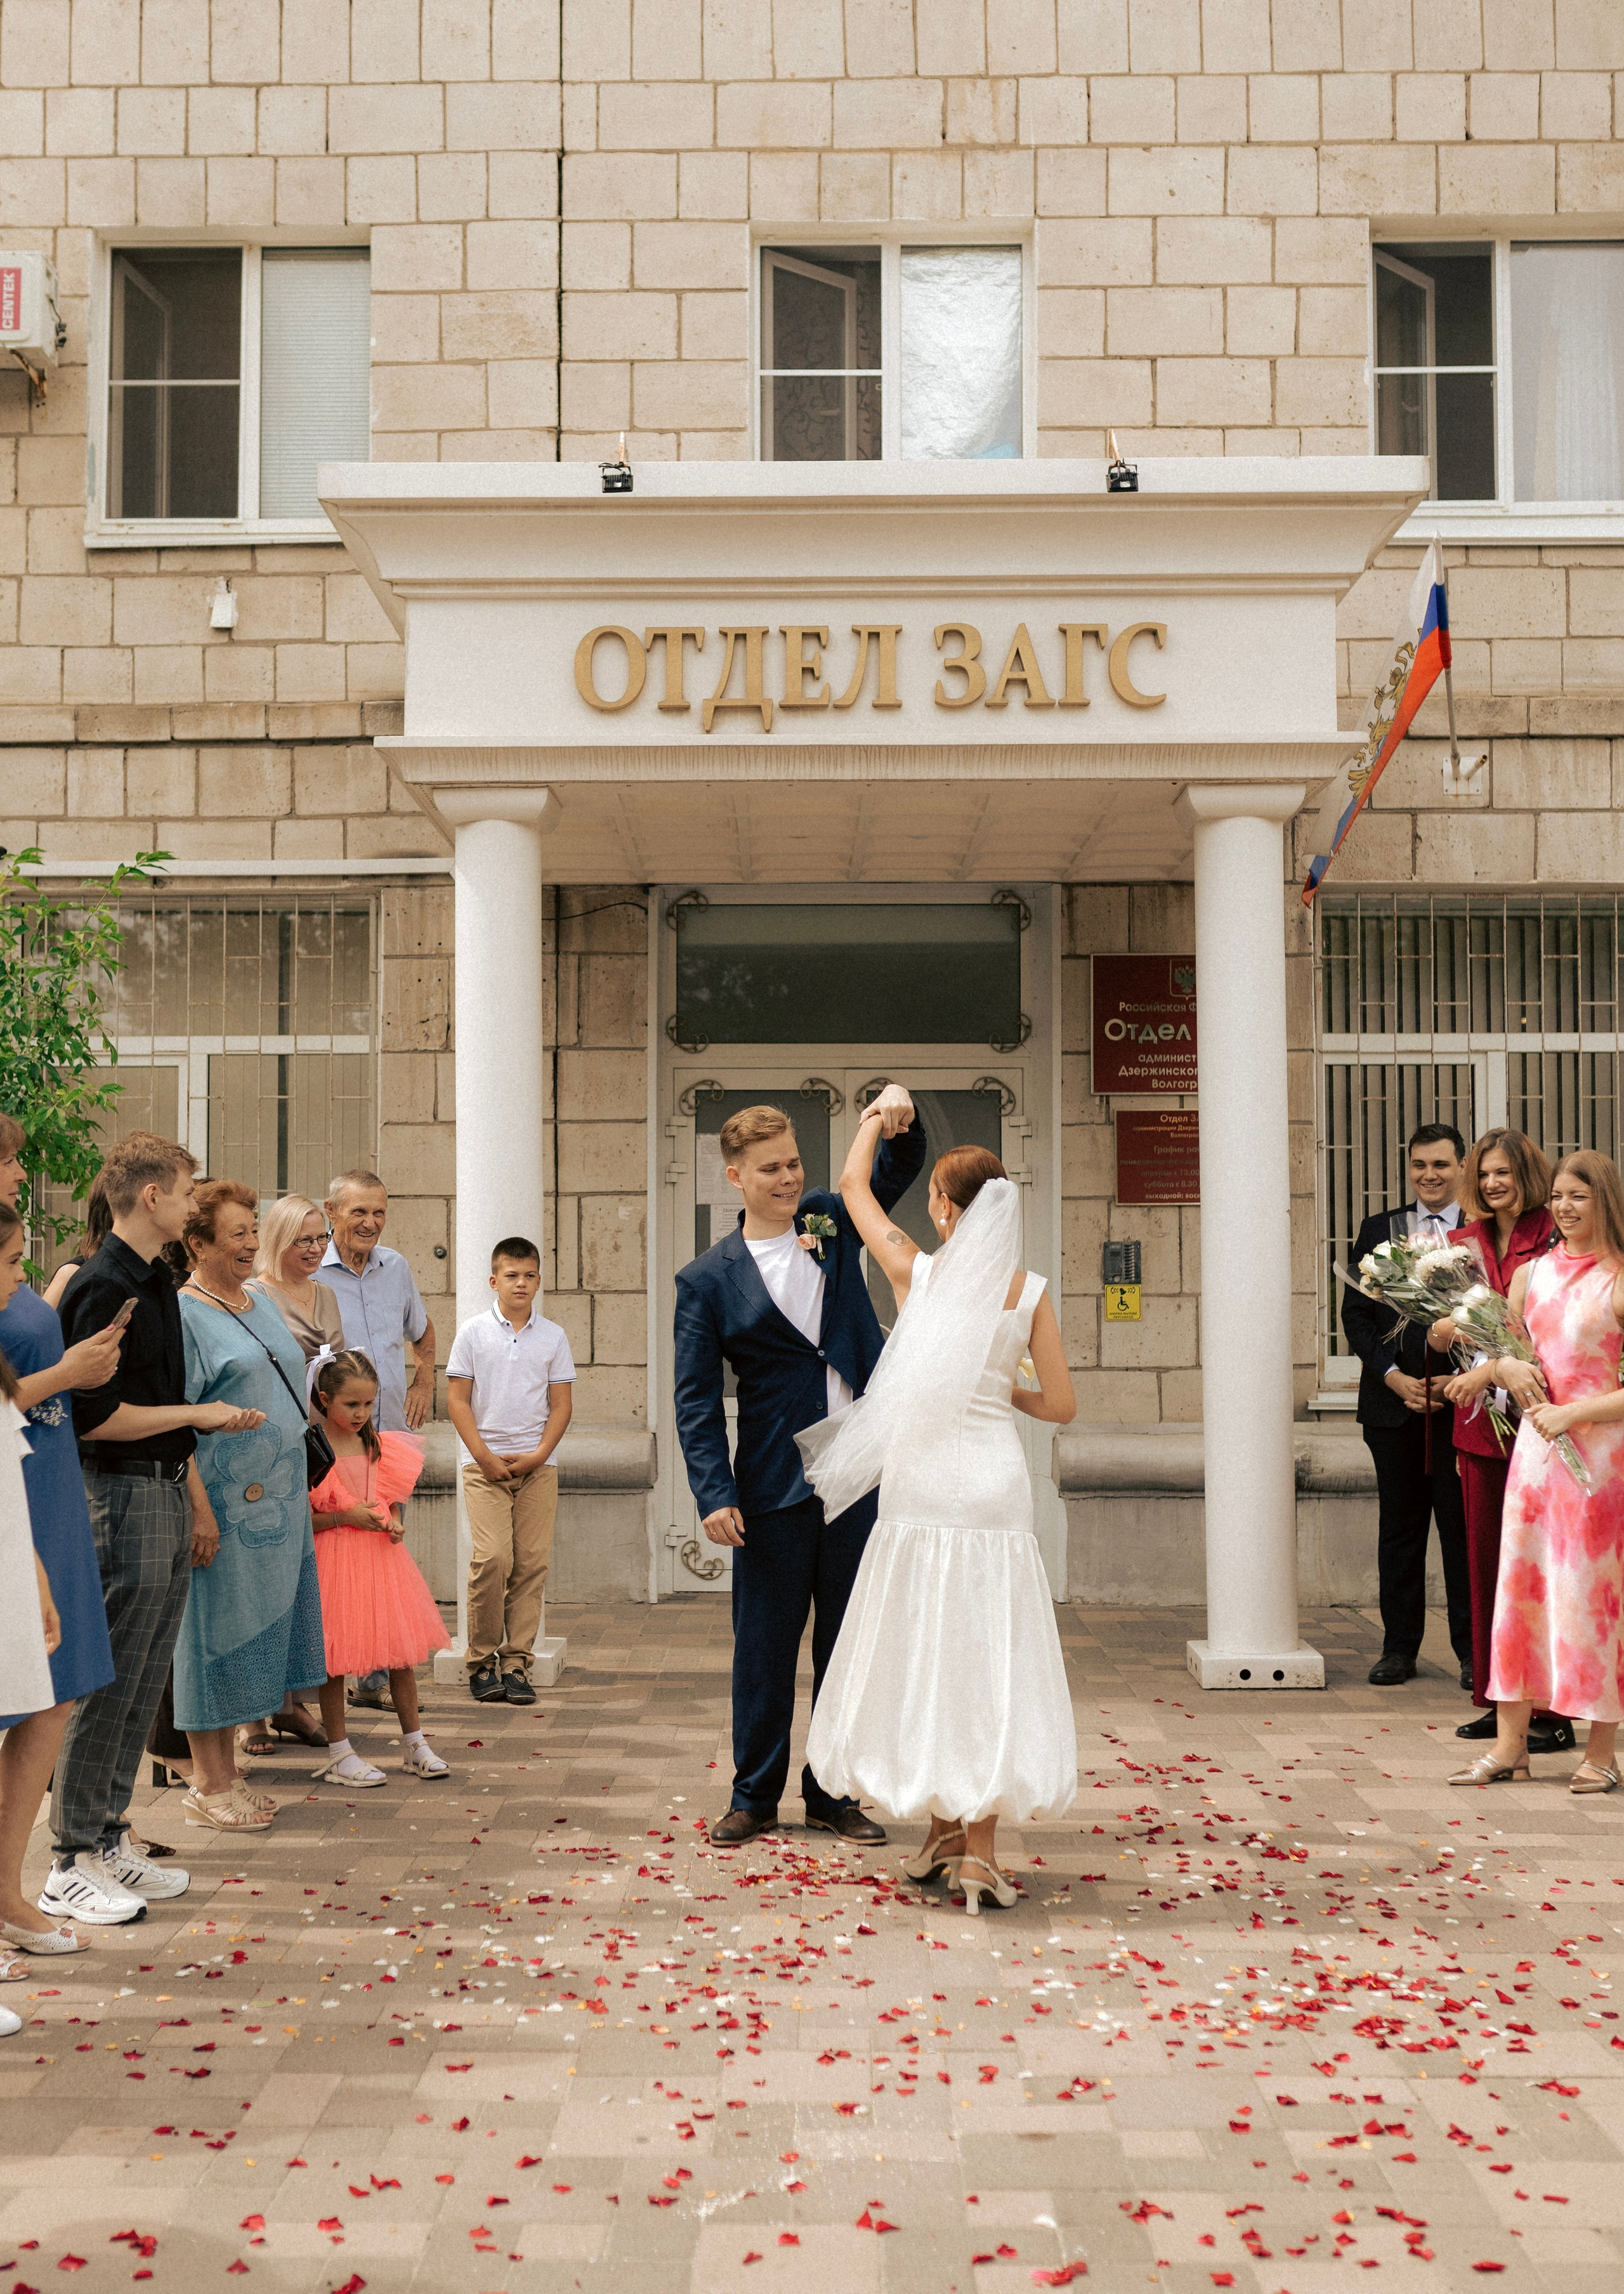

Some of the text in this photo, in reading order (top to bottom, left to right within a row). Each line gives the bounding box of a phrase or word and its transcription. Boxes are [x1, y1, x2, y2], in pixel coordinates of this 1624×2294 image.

[2, 272, 15, 329] CENTEK
[573, 622, 1169, 734] ОТДЕЛ ЗАГС
[1119, 1001, 1186, 1013] Российская
[1104, 1018, 1192, 1044] Отдел
[1138, 1054, 1196, 1064] админист
[1160, 1114, 1188, 1124] Отдел
[1154, 1144, 1184, 1155] График
[1144, 1179, 1174, 1190] суббота
